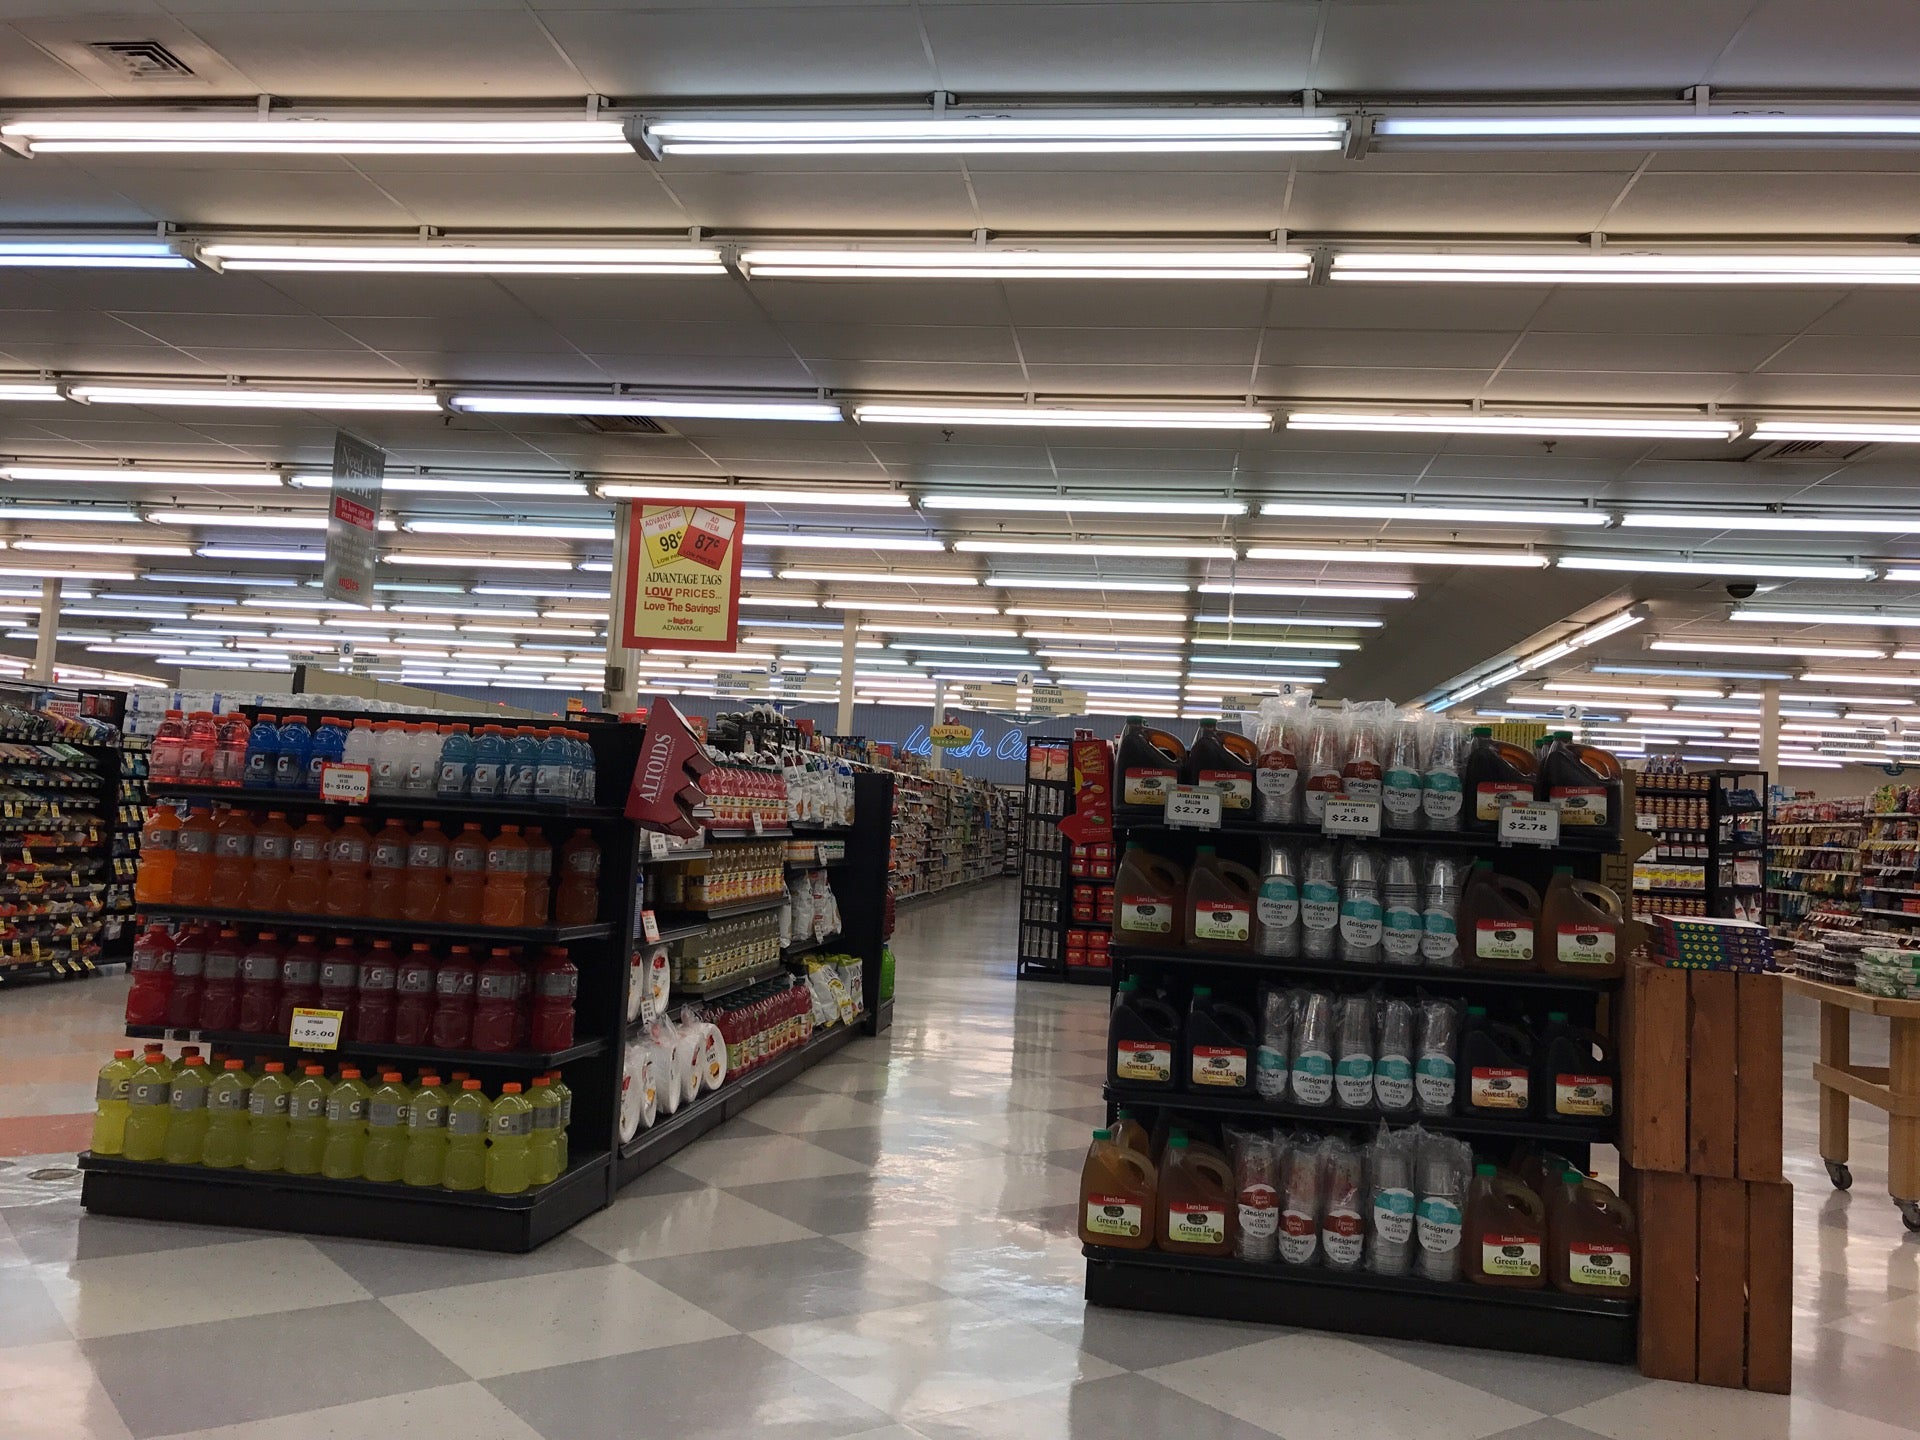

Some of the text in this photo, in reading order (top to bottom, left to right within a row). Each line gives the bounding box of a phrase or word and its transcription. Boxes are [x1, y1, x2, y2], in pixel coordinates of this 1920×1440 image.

[645, 511, 681, 527] ADVANTAGE
[658, 522, 672, 531] BUY
[704, 522, 720, 532] ITEM
[645, 572, 722, 586] ADVANTAGE TAGS
[645, 586, 673, 596] LOW
[644, 601, 721, 615] Love The Savings!
[343, 643, 350, 654] 6
[770, 662, 777, 673] 5
[1022, 674, 1028, 685] 4
[1284, 684, 1291, 694] 3
[1569, 707, 1577, 718] 2
[1892, 720, 1897, 732] 1
[933, 728, 970, 737] NATURAL
[251, 755, 265, 769] G
[277, 757, 289, 771] G
[639, 733, 673, 805] ALTOIDS
[1134, 788, 1156, 796] Sweet
[1229, 791, 1243, 800] Tea
[1174, 805, 1210, 815] $2.78
[1559, 808, 1597, 817] Sweet Tea
[1332, 814, 1368, 823] $2.88
[1509, 822, 1547, 831] $2.78
[151, 831, 161, 842] G
[179, 833, 188, 844] G
[227, 837, 237, 848] G
[263, 839, 274, 850] G
[339, 842, 350, 853] G
[377, 848, 386, 858] G
[419, 848, 428, 858] G
[455, 851, 464, 861] G
[488, 852, 497, 863] G
[1262, 902, 1292, 911] designer
[1304, 903, 1336, 912] designer
[1347, 920, 1378, 930] designer
[132, 951, 139, 962] G
[162, 952, 171, 963] G
[245, 959, 253, 970] G
[284, 963, 291, 974] G
[324, 966, 333, 977] G
[371, 970, 381, 981] G
[408, 972, 417, 983] G
[463, 974, 473, 985] G
[481, 977, 490, 988] G
[1127, 1062, 1161, 1072] Sweet Tea
[1202, 1068, 1223, 1076] Sweet
[118, 1081, 128, 1092] G
[137, 1086, 147, 1097] G
[173, 1090, 182, 1101] G
[219, 1091, 230, 1103] G
[1482, 1089, 1518, 1099] Sweet Tea
[275, 1095, 285, 1106] G
[308, 1099, 318, 1110] G
[350, 1101, 360, 1113] G
[397, 1106, 406, 1117] G
[427, 1109, 437, 1120] G
[500, 1116, 509, 1128] G
[1096, 1215, 1131, 1226] Green Tea
[1179, 1224, 1215, 1233] Green Tea
[1421, 1222, 1454, 1234] designer
[1494, 1256, 1532, 1267] Green Tea
[1582, 1265, 1621, 1277] Green Tea
